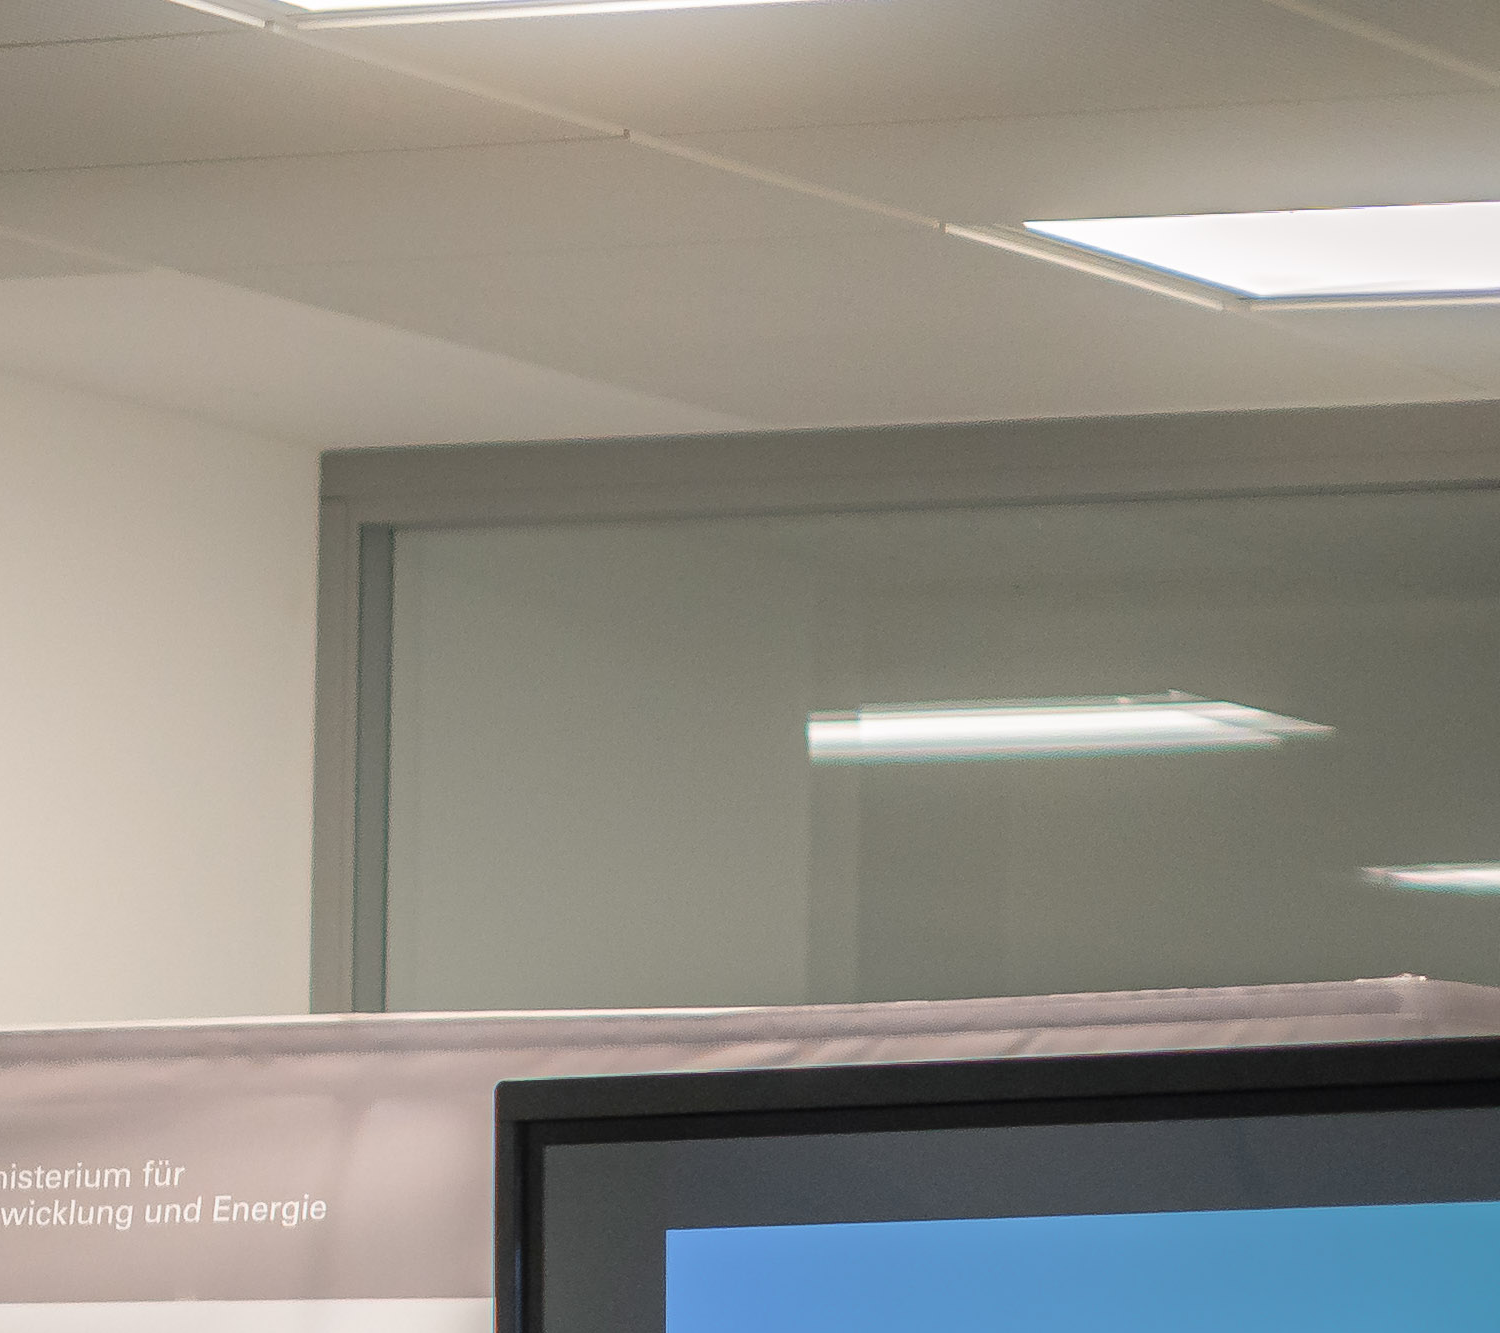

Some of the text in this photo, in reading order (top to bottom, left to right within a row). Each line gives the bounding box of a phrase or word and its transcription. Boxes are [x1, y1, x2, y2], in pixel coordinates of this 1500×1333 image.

[142, 1159, 186, 1190] für
[144, 1196, 202, 1226] und
[212, 1194, 328, 1227] Energie
